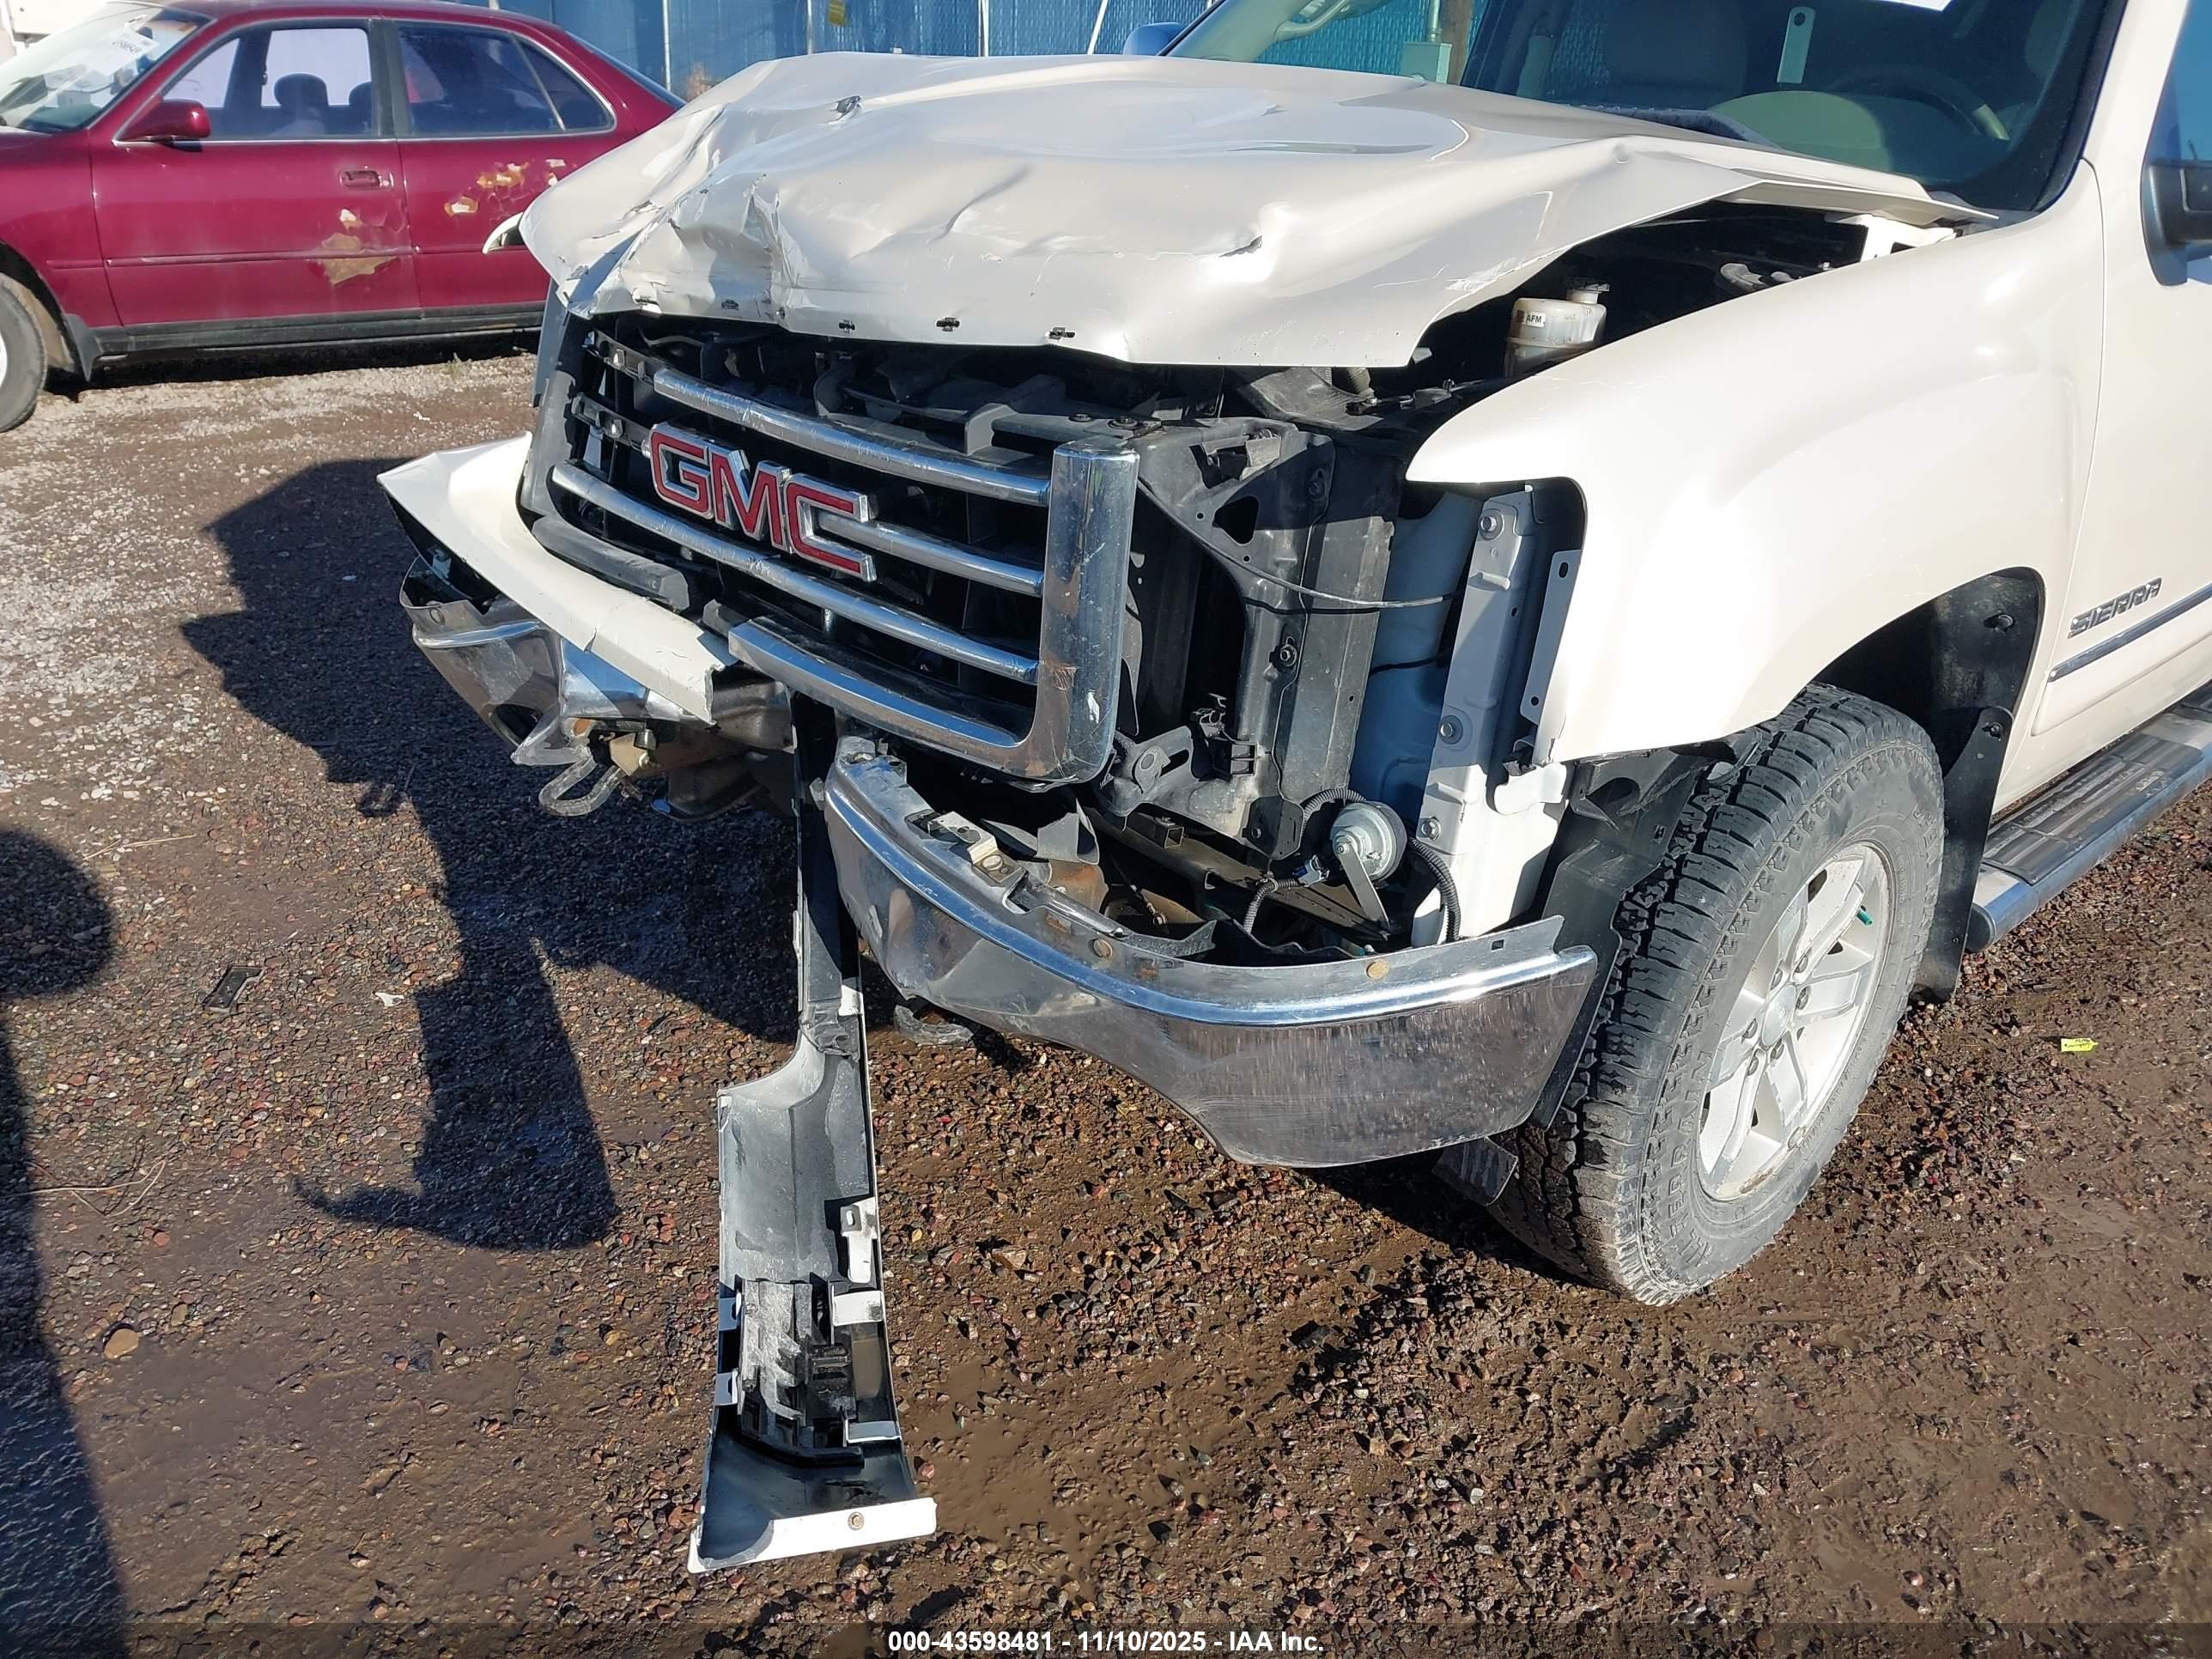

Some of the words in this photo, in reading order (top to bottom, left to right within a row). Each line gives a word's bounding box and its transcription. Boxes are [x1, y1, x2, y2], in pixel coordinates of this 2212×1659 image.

[1526, 314, 1542, 324] AFM
[649, 422, 877, 582] GMC
[2068, 577, 2162, 639] SIERRA
